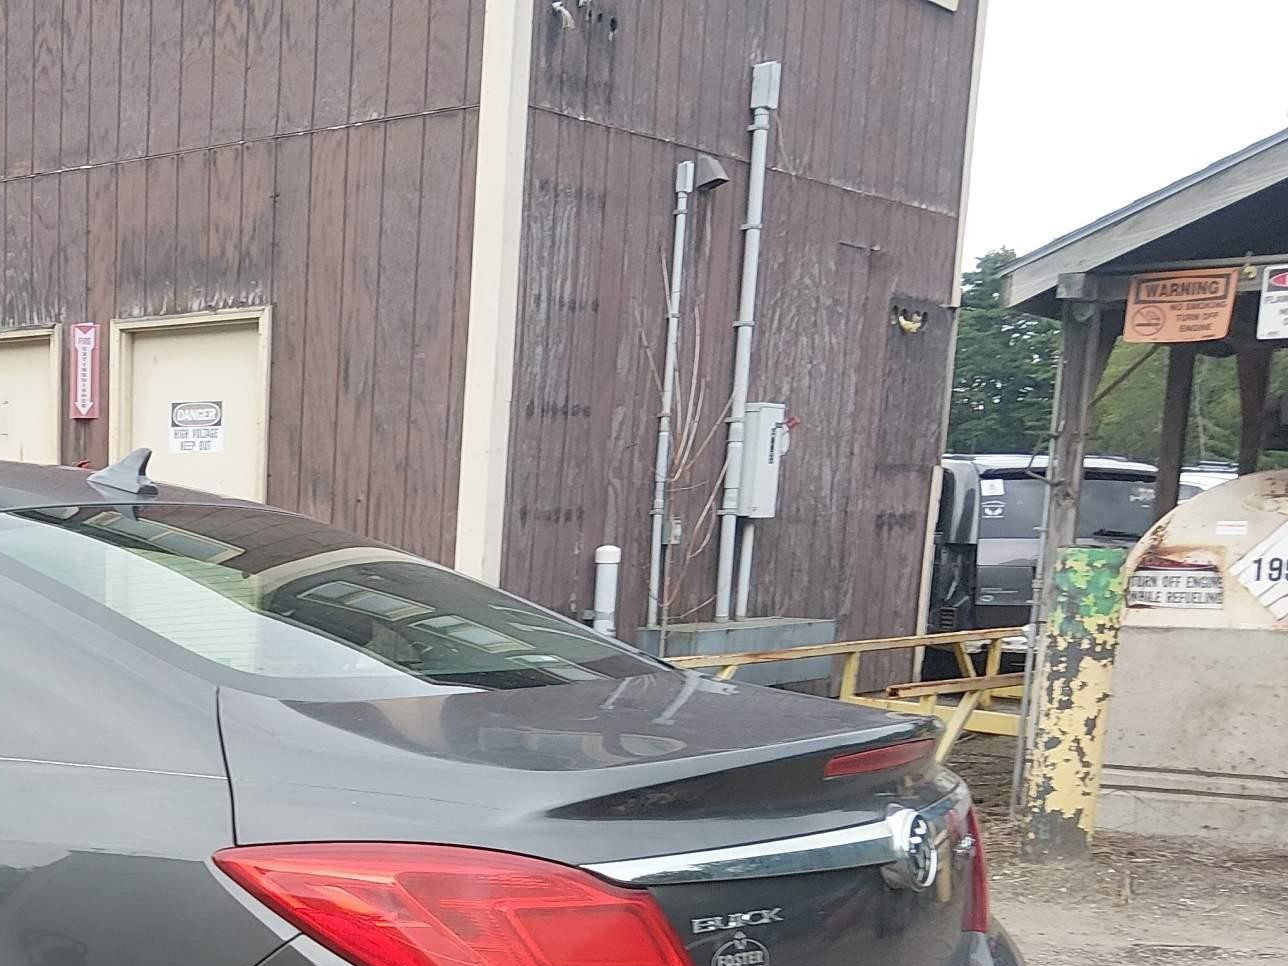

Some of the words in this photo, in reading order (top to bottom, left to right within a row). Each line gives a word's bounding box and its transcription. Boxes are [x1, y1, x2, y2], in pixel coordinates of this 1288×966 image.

[1145, 280, 1220, 298] WARNING
[1169, 303, 1183, 312] NO
[1186, 301, 1227, 310] SMOKING
[1176, 313, 1200, 322] TURN
[1202, 312, 1219, 321] OFF
[1179, 323, 1212, 333] ENGINE
[176, 408, 218, 421] DANGER
[192, 428, 218, 439] VOLTAGE
[199, 440, 213, 451] OUT
[1130, 575, 1158, 588] TURN
[1162, 575, 1182, 588] OFF
[1186, 576, 1223, 588] ENGINE
[1130, 590, 1161, 602] WHILE
[1167, 591, 1223, 604] REFUELING
[691, 907, 785, 934] BUICK
